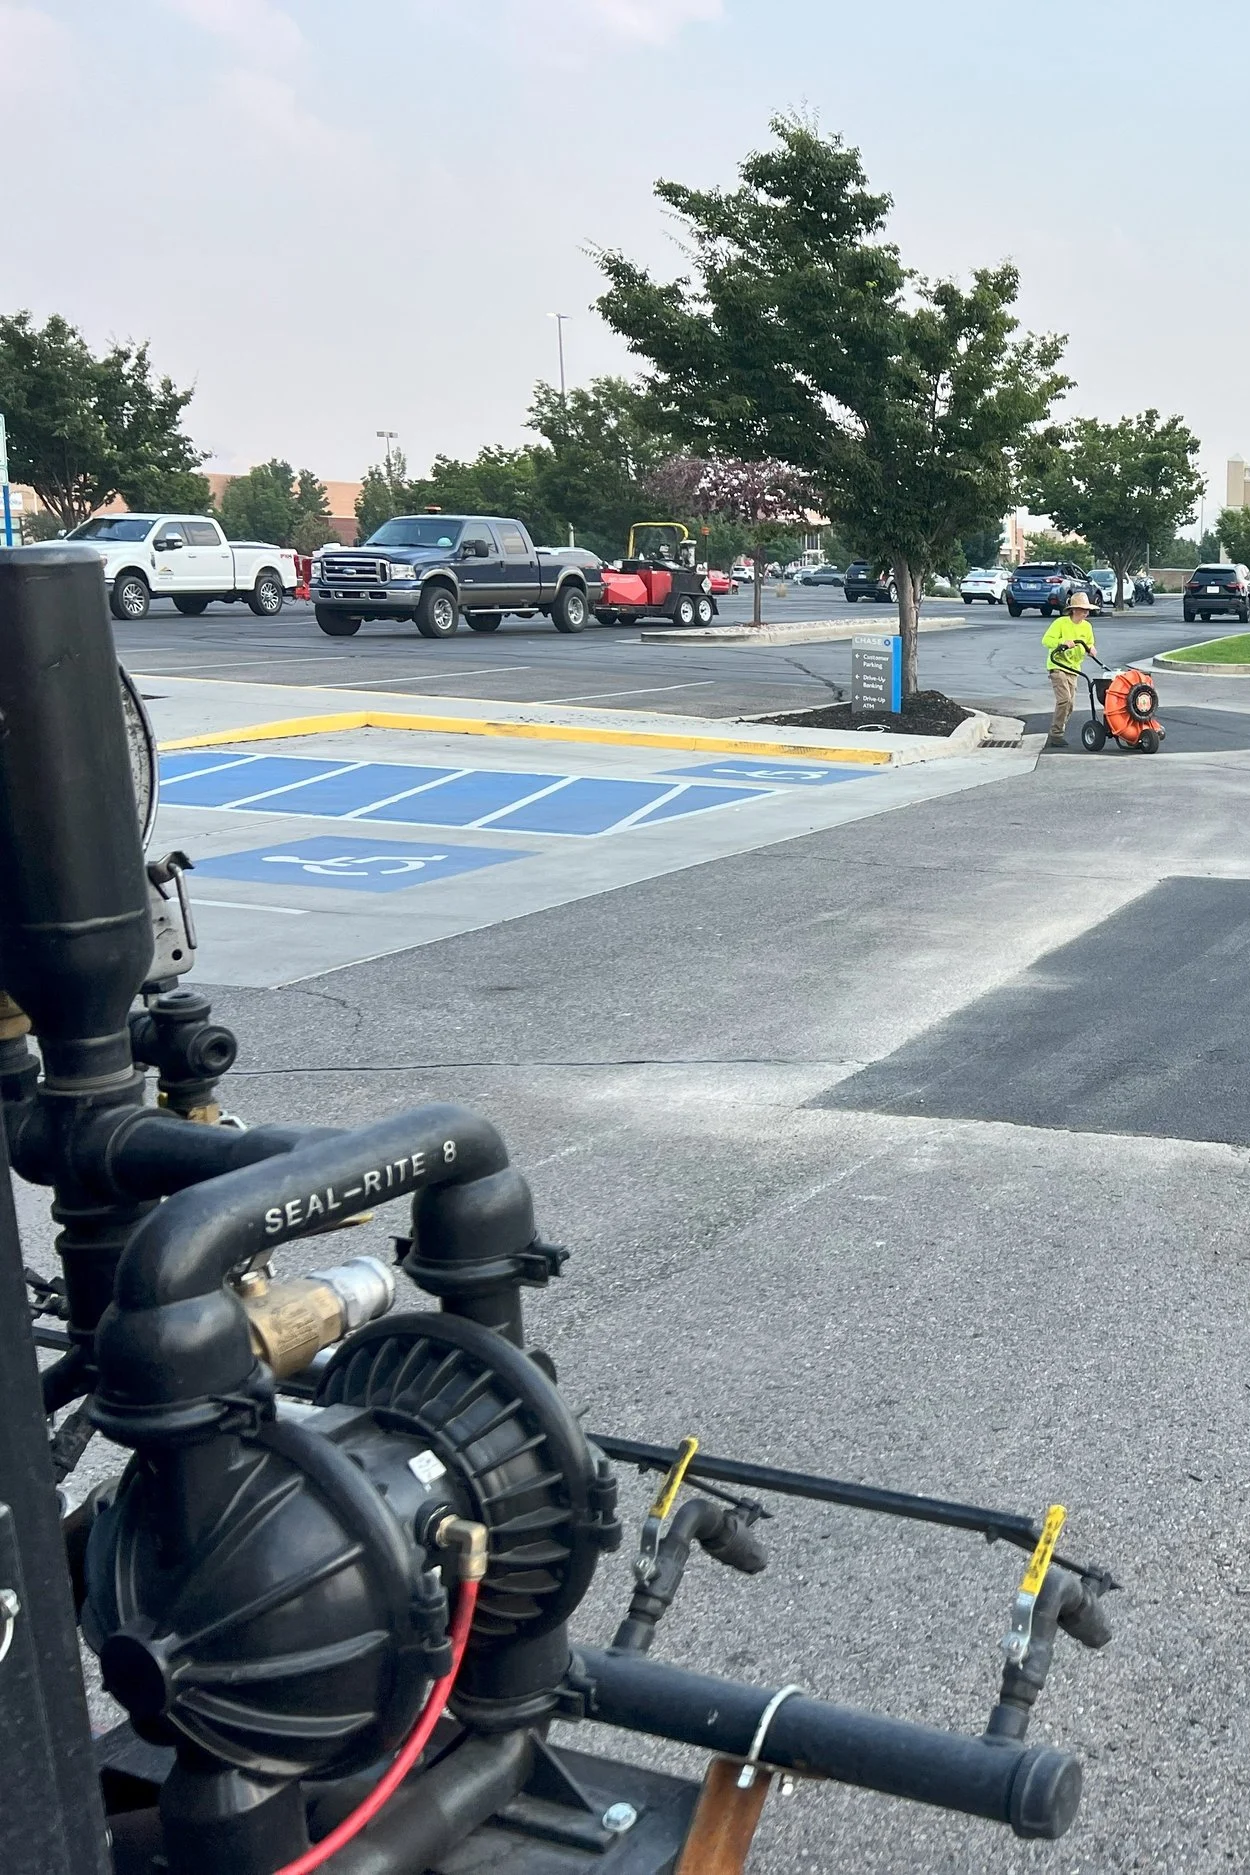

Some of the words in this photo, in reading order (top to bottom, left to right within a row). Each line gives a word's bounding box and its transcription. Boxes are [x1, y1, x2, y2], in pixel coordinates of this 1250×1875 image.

[854, 637, 883, 646] CHASE
[863, 654, 889, 662] Customer
[863, 662, 883, 670] Parking
[863, 675, 886, 683] Drive-Up
[863, 683, 883, 691] Banking
[863, 696, 886, 704] Drive-Up
[264, 1151, 426, 1235] SEAL-RITE
[443, 1140, 457, 1163] 8
